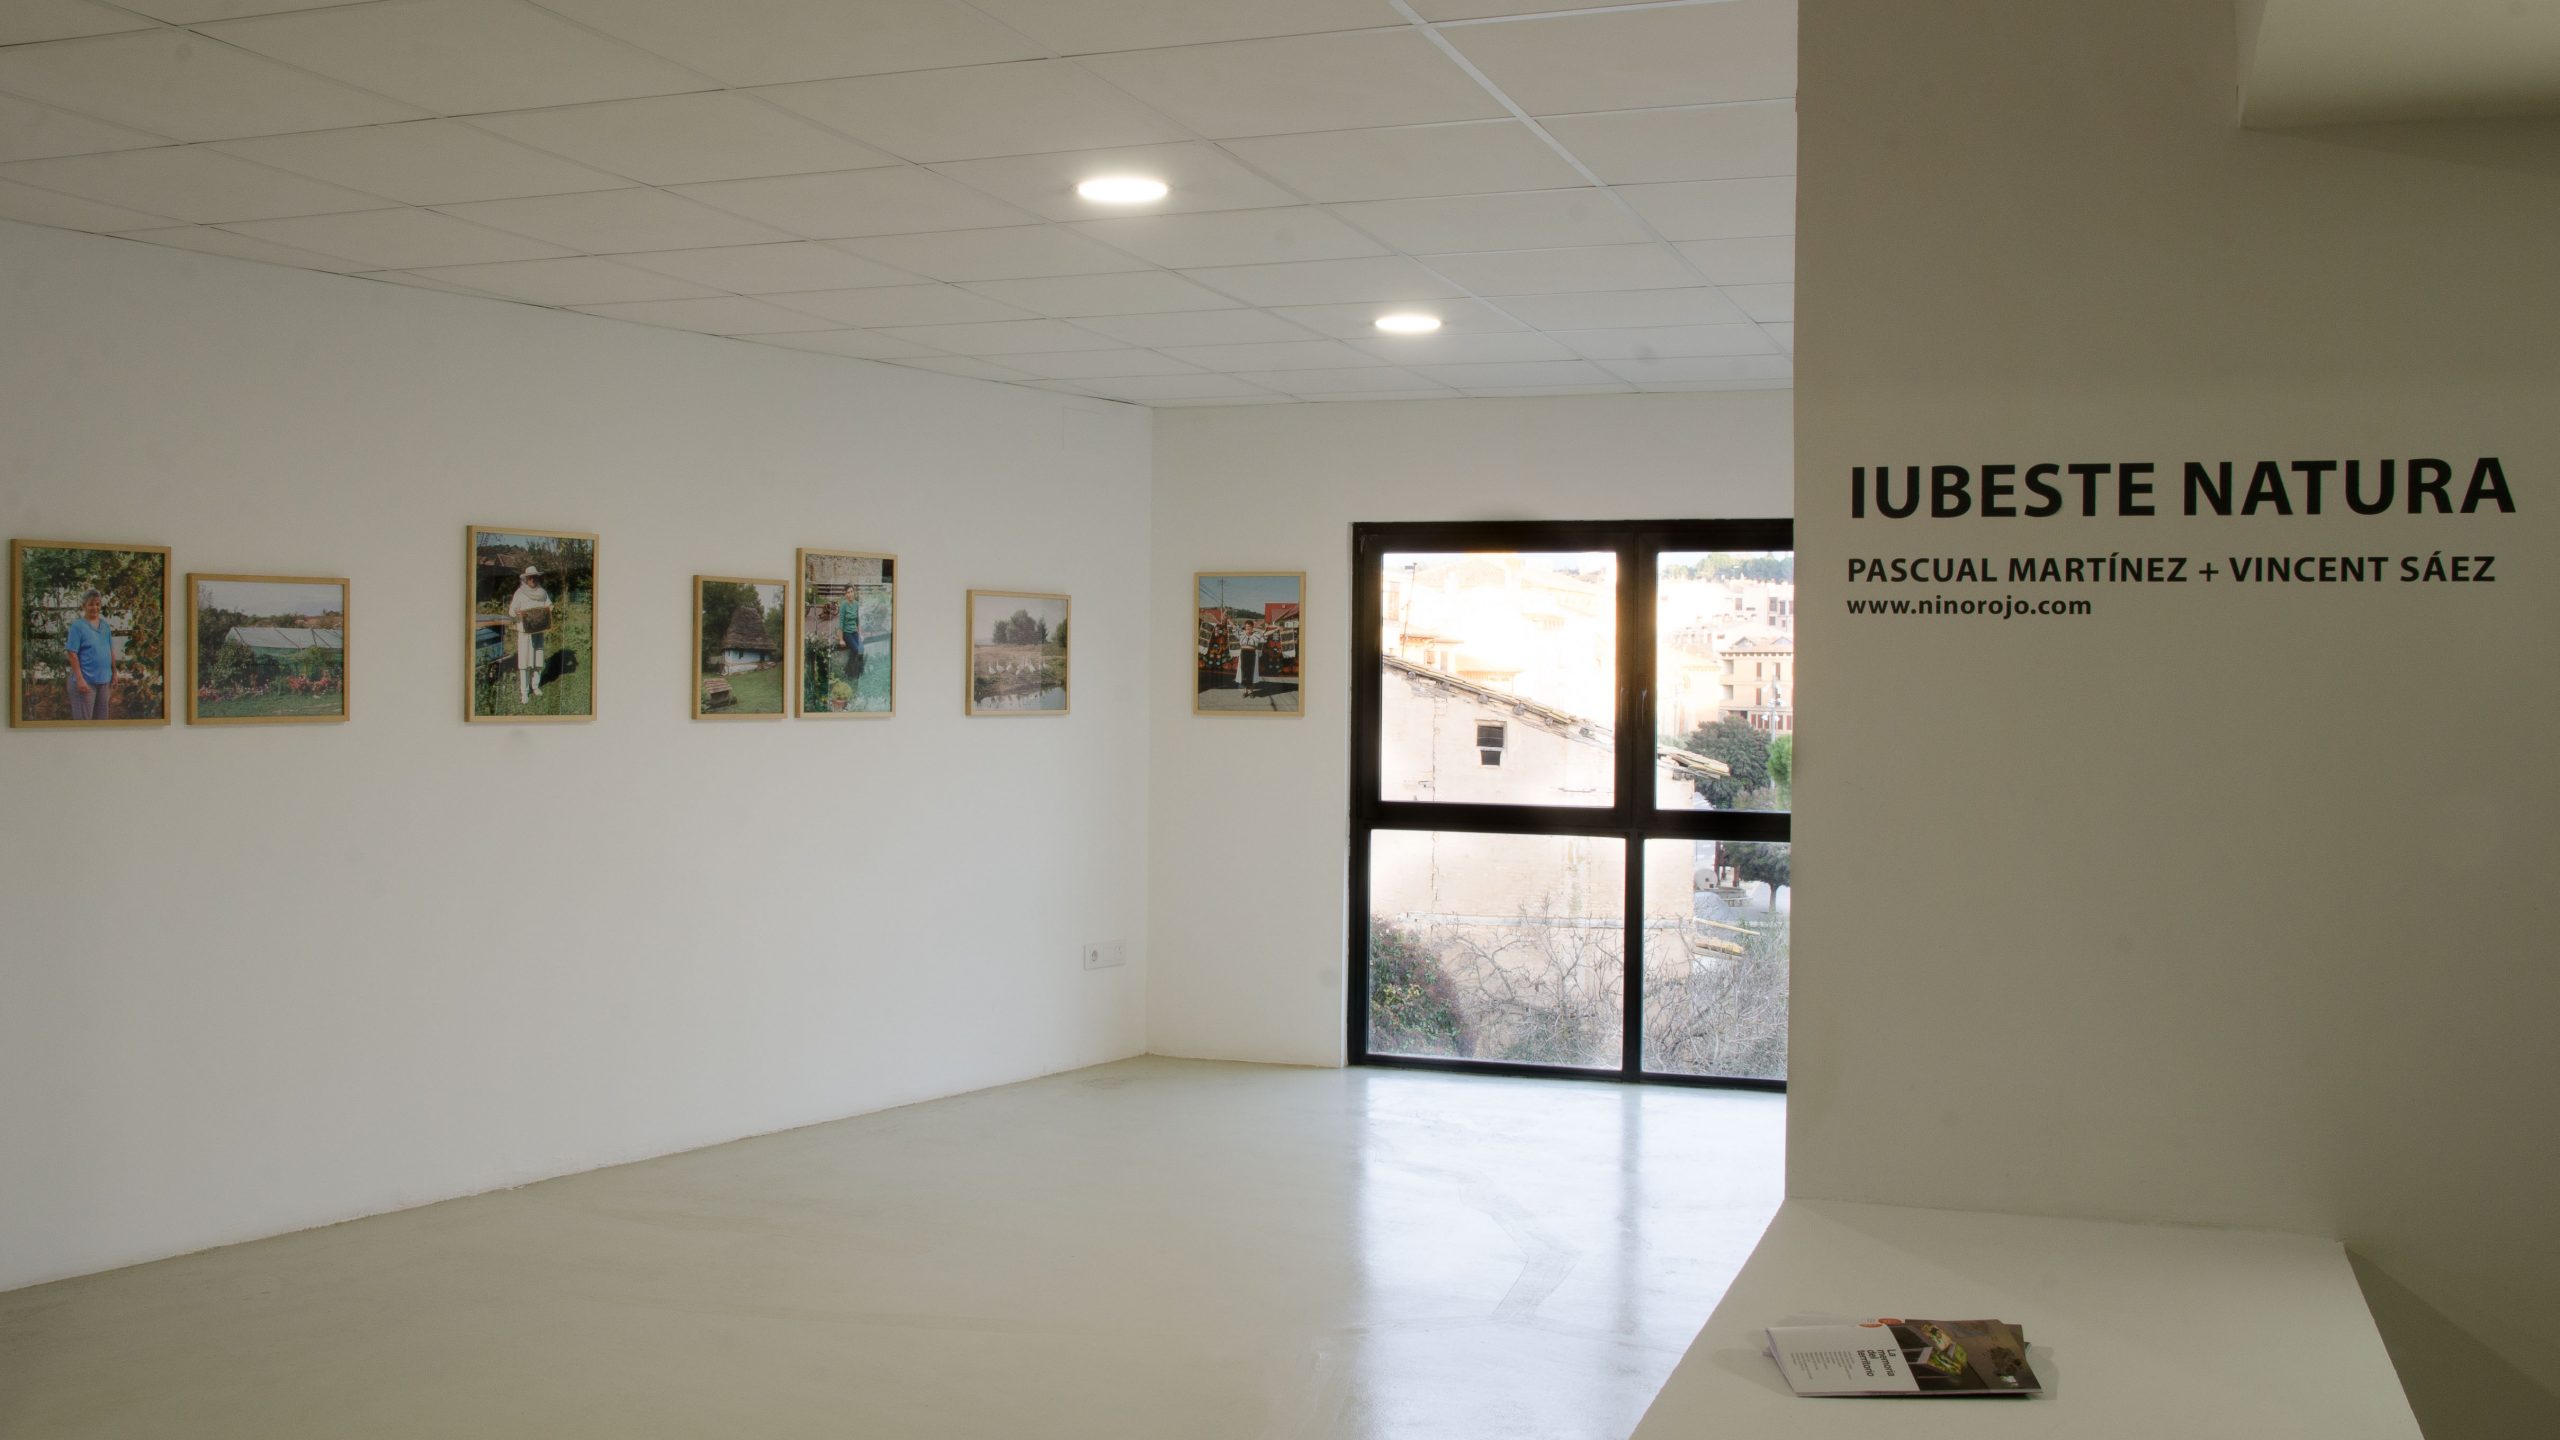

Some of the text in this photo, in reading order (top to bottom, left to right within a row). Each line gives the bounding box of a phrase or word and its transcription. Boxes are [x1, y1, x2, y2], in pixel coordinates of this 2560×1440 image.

[1851, 456, 2517, 519] IUBESTE NATURA
[1848, 550, 2496, 583] PASCUAL MARTÍNEZ + VINCENT SÁEZ
[1846, 595, 2092, 620] www.ninorojo.com
[1857, 1349, 1875, 1377] territorio
[1867, 1349, 1878, 1360] del
[1877, 1349, 1895, 1377] memoria
[1886, 1349, 1897, 1357] La
